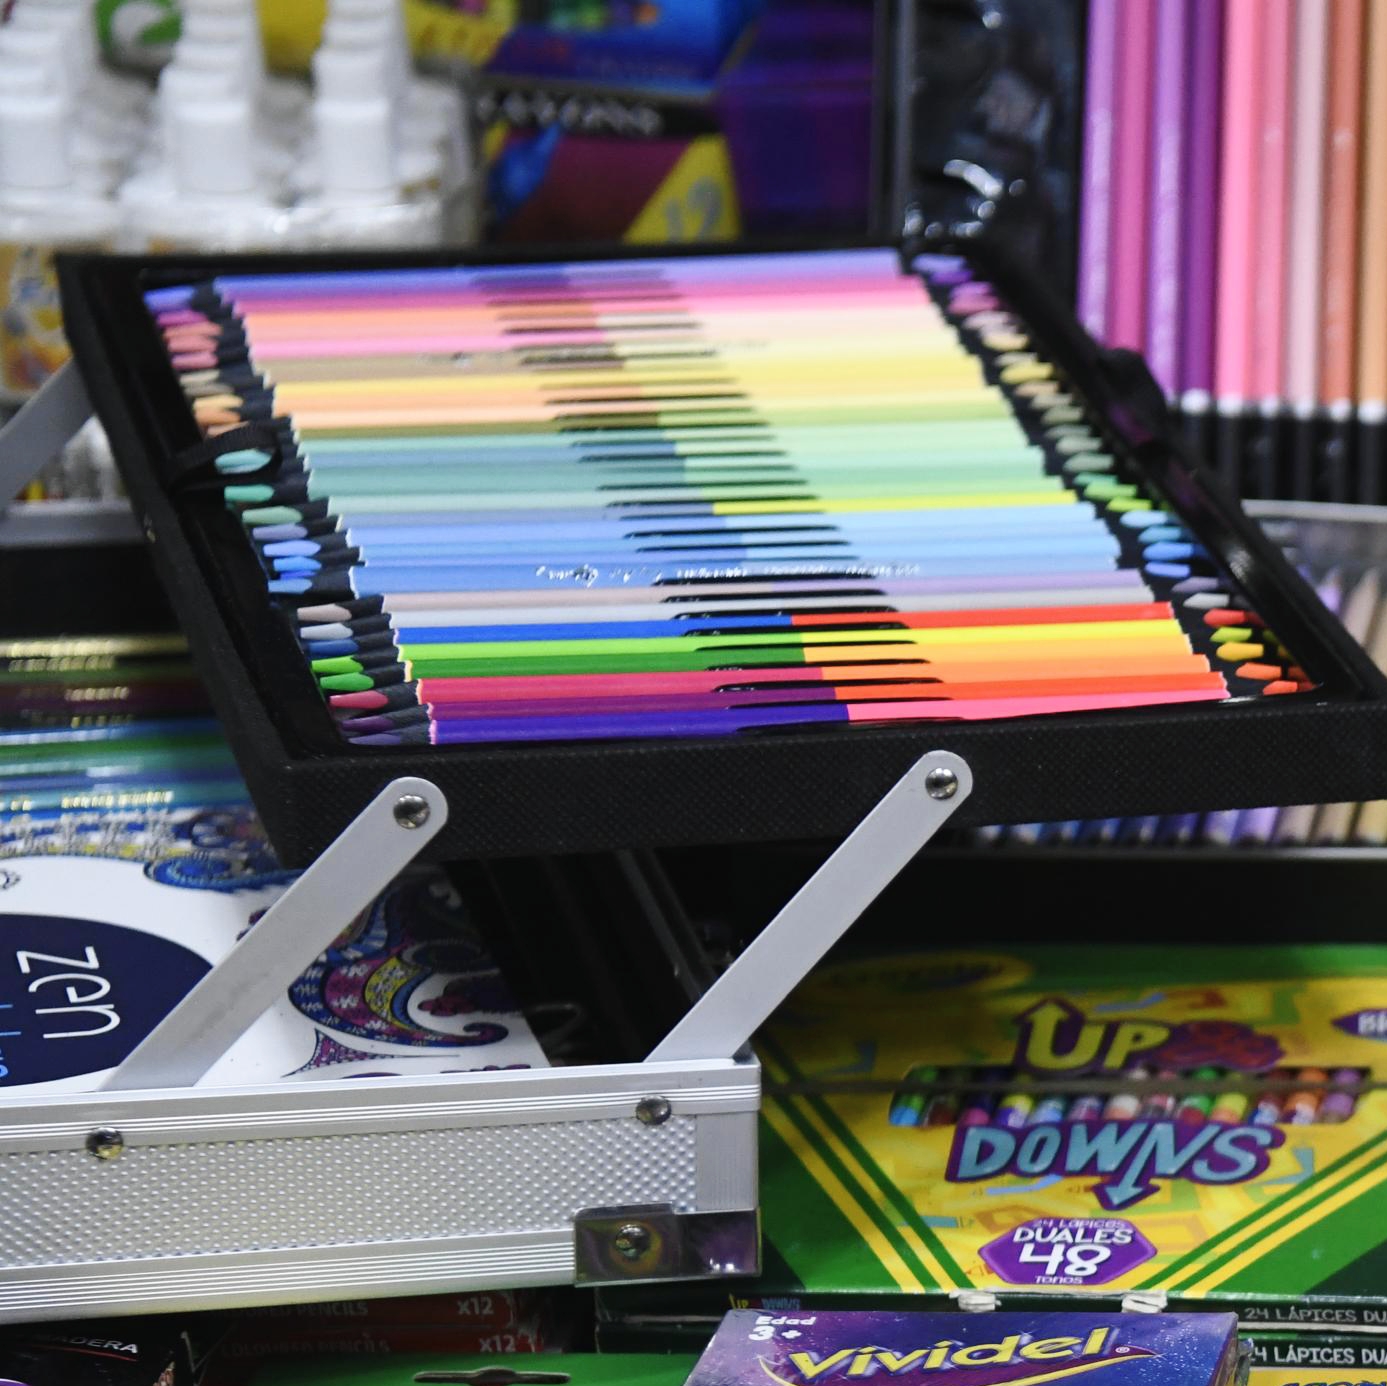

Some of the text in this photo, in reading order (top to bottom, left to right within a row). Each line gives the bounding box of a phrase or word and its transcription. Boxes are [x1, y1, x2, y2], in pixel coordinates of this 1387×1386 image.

[1025, 1003, 1171, 1071] UP
[957, 1122, 1278, 1205] DOWNS
[1013, 1227, 1133, 1244] DUALES
[1018, 1243, 1112, 1277] 48
[755, 1316, 817, 1326] Edad
[1245, 1308, 1278, 1324] 24
[1283, 1304, 1360, 1325] LÁPICES
[1271, 1341, 1352, 1366] LÁPICES
